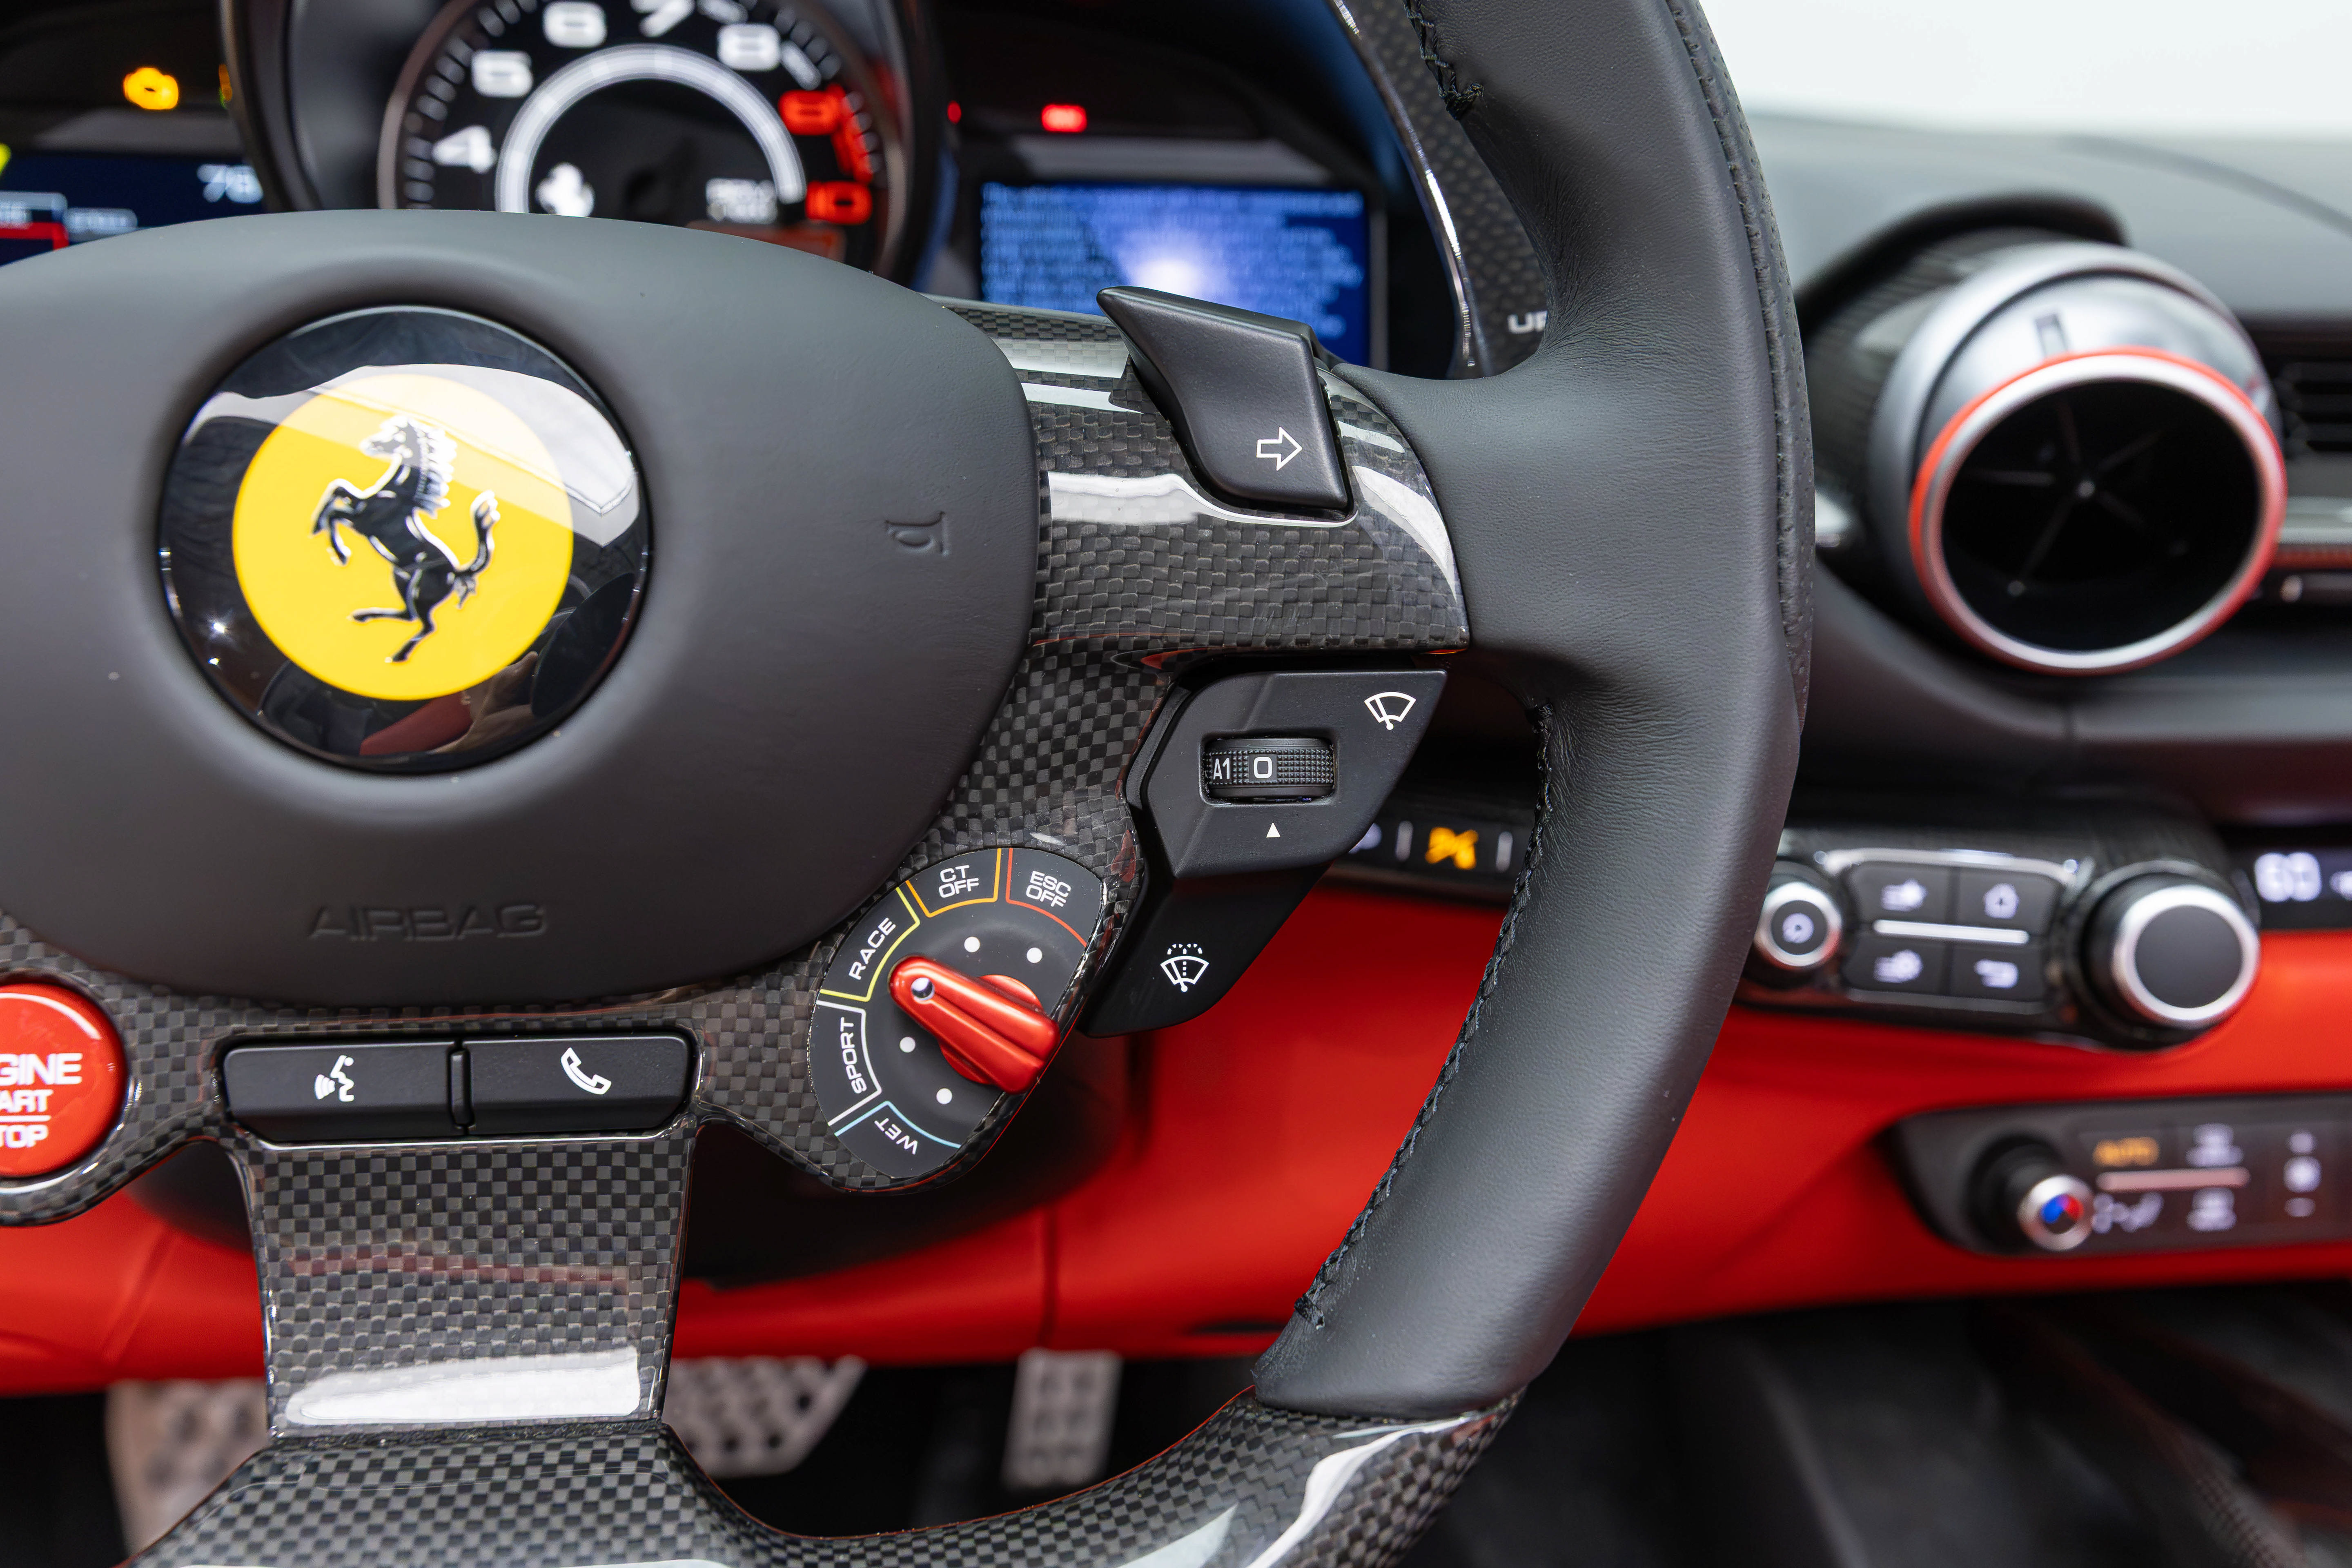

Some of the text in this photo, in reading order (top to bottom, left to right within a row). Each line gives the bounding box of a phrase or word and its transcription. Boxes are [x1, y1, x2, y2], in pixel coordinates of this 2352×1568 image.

[1213, 758, 1230, 780] A1
[940, 865, 970, 882] CT
[1030, 871, 1071, 897] ESC
[939, 878, 979, 898] OFF
[1026, 884, 1066, 907] OFF
[849, 918, 896, 980] RACE
[840, 1017, 867, 1094] SPORT
[874, 1118, 918, 1155] WET
